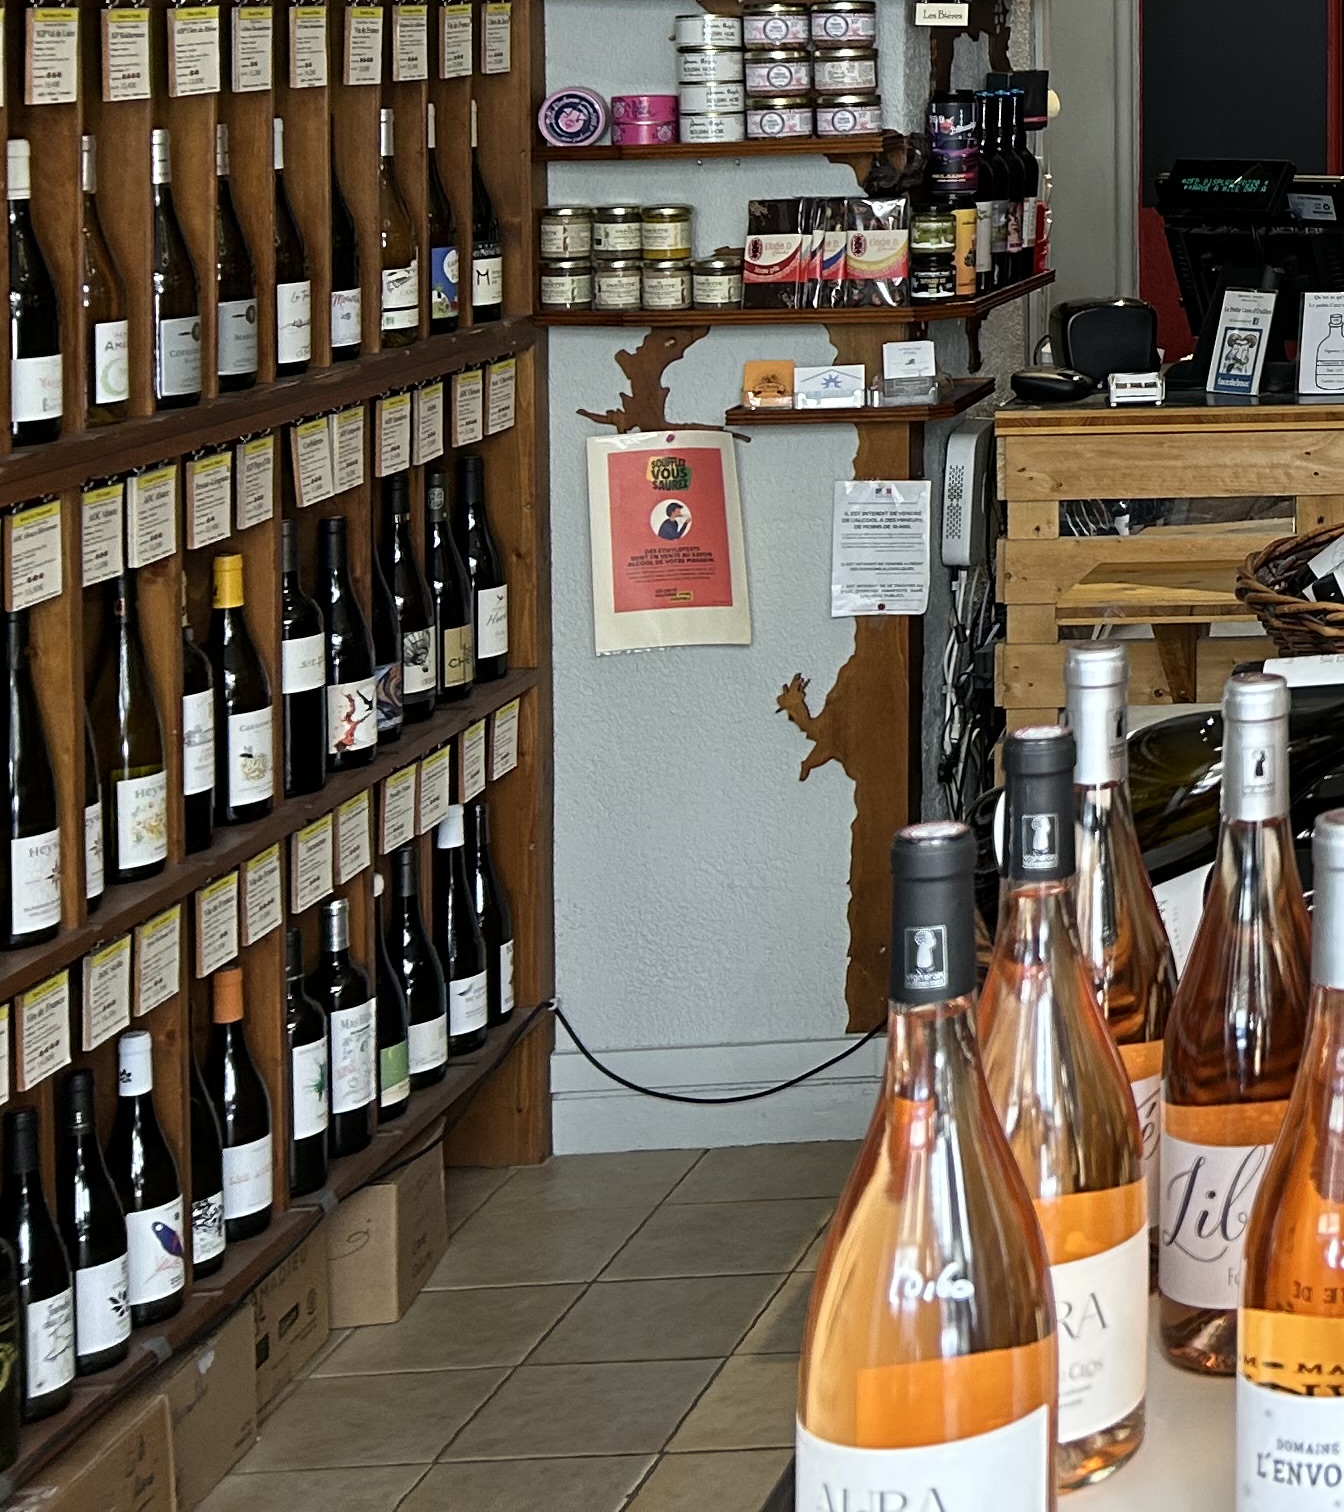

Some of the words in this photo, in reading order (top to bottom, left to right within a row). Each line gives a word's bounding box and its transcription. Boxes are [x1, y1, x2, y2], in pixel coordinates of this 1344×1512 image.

[923, 10, 936, 19] Les
[651, 467, 688, 480] VOUS
[1276, 1439, 1340, 1454] DOMAINE
